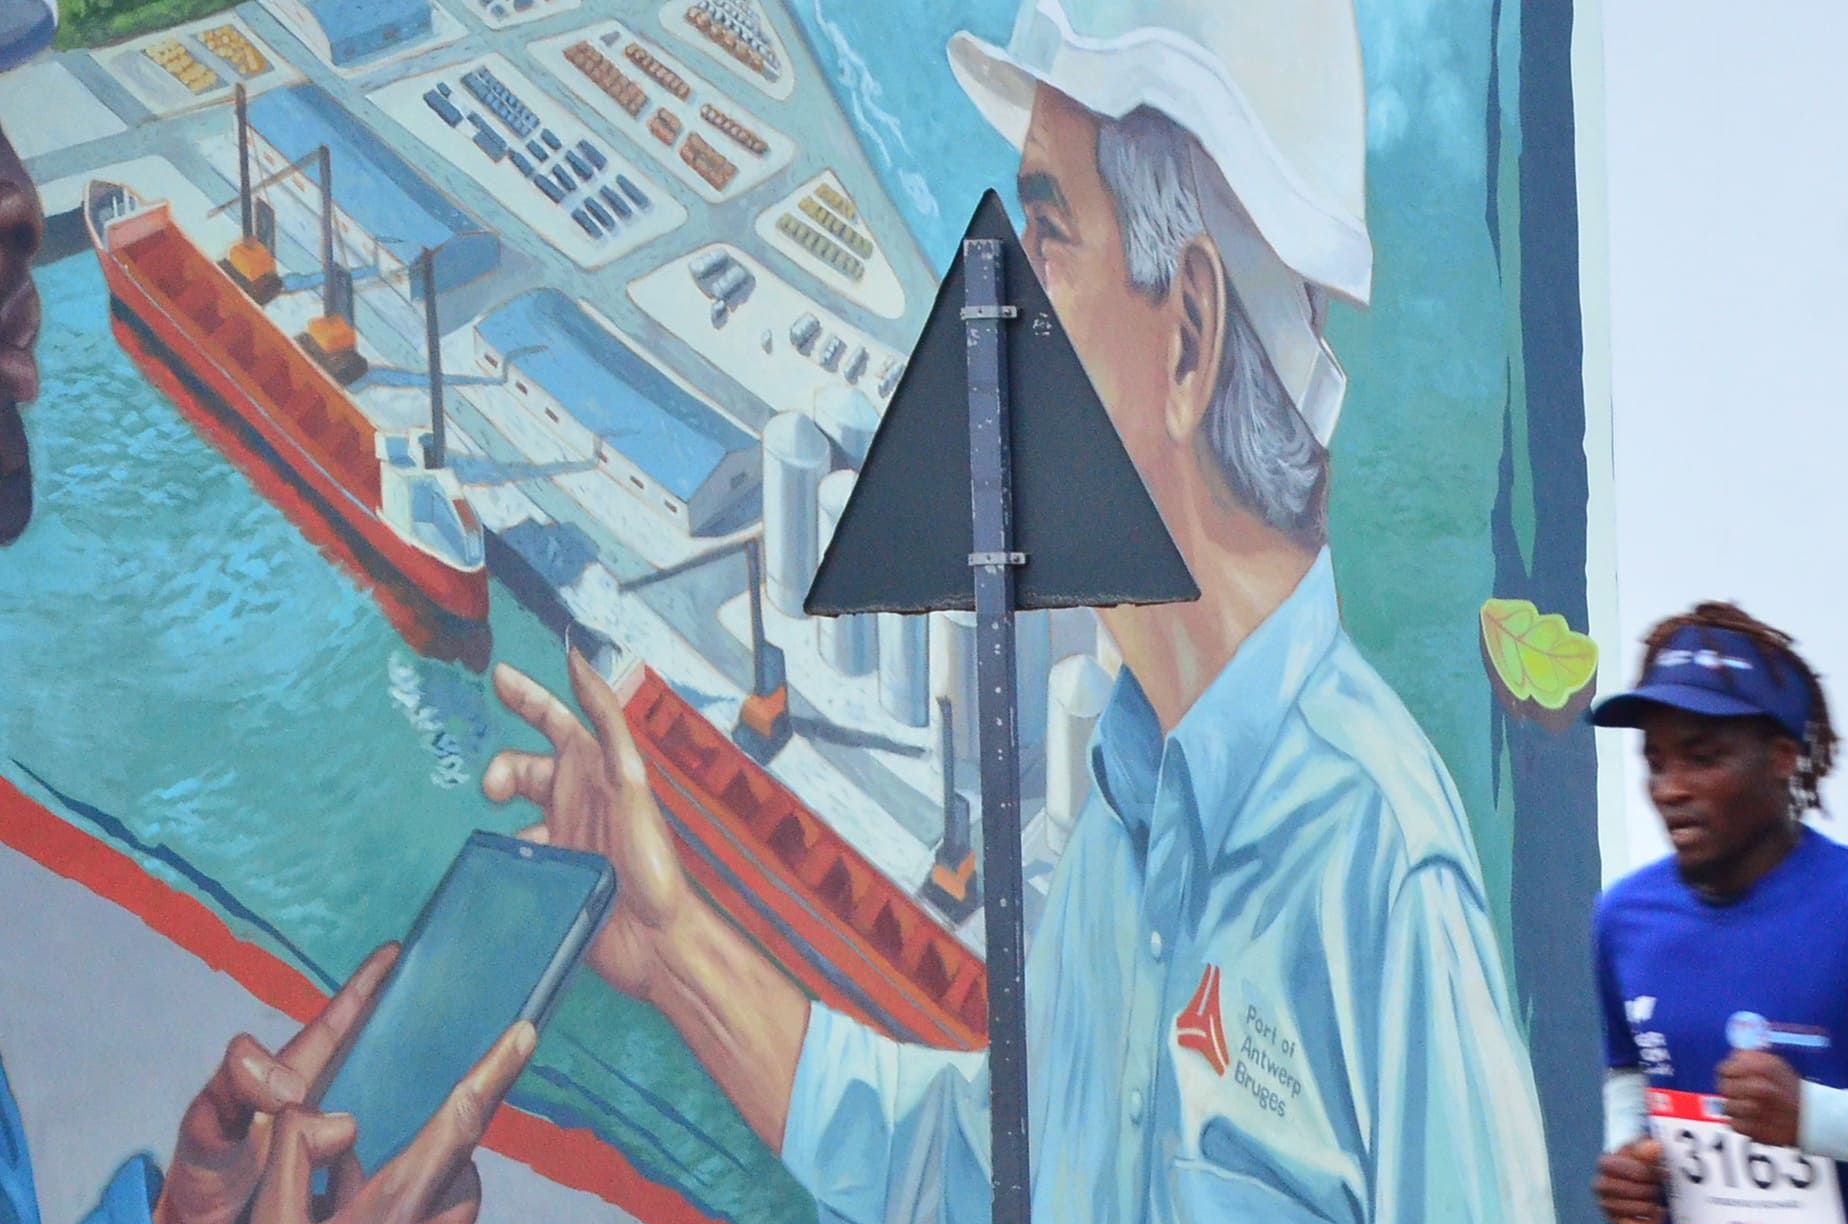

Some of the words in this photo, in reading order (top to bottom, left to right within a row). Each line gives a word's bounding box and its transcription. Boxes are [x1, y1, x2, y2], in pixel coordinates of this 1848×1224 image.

[1246, 1003, 1277, 1046] Port
[1234, 1060, 1286, 1118] Bruges
[1240, 1035, 1302, 1098] Antwerp
[1675, 1130, 1816, 1189] 3163
